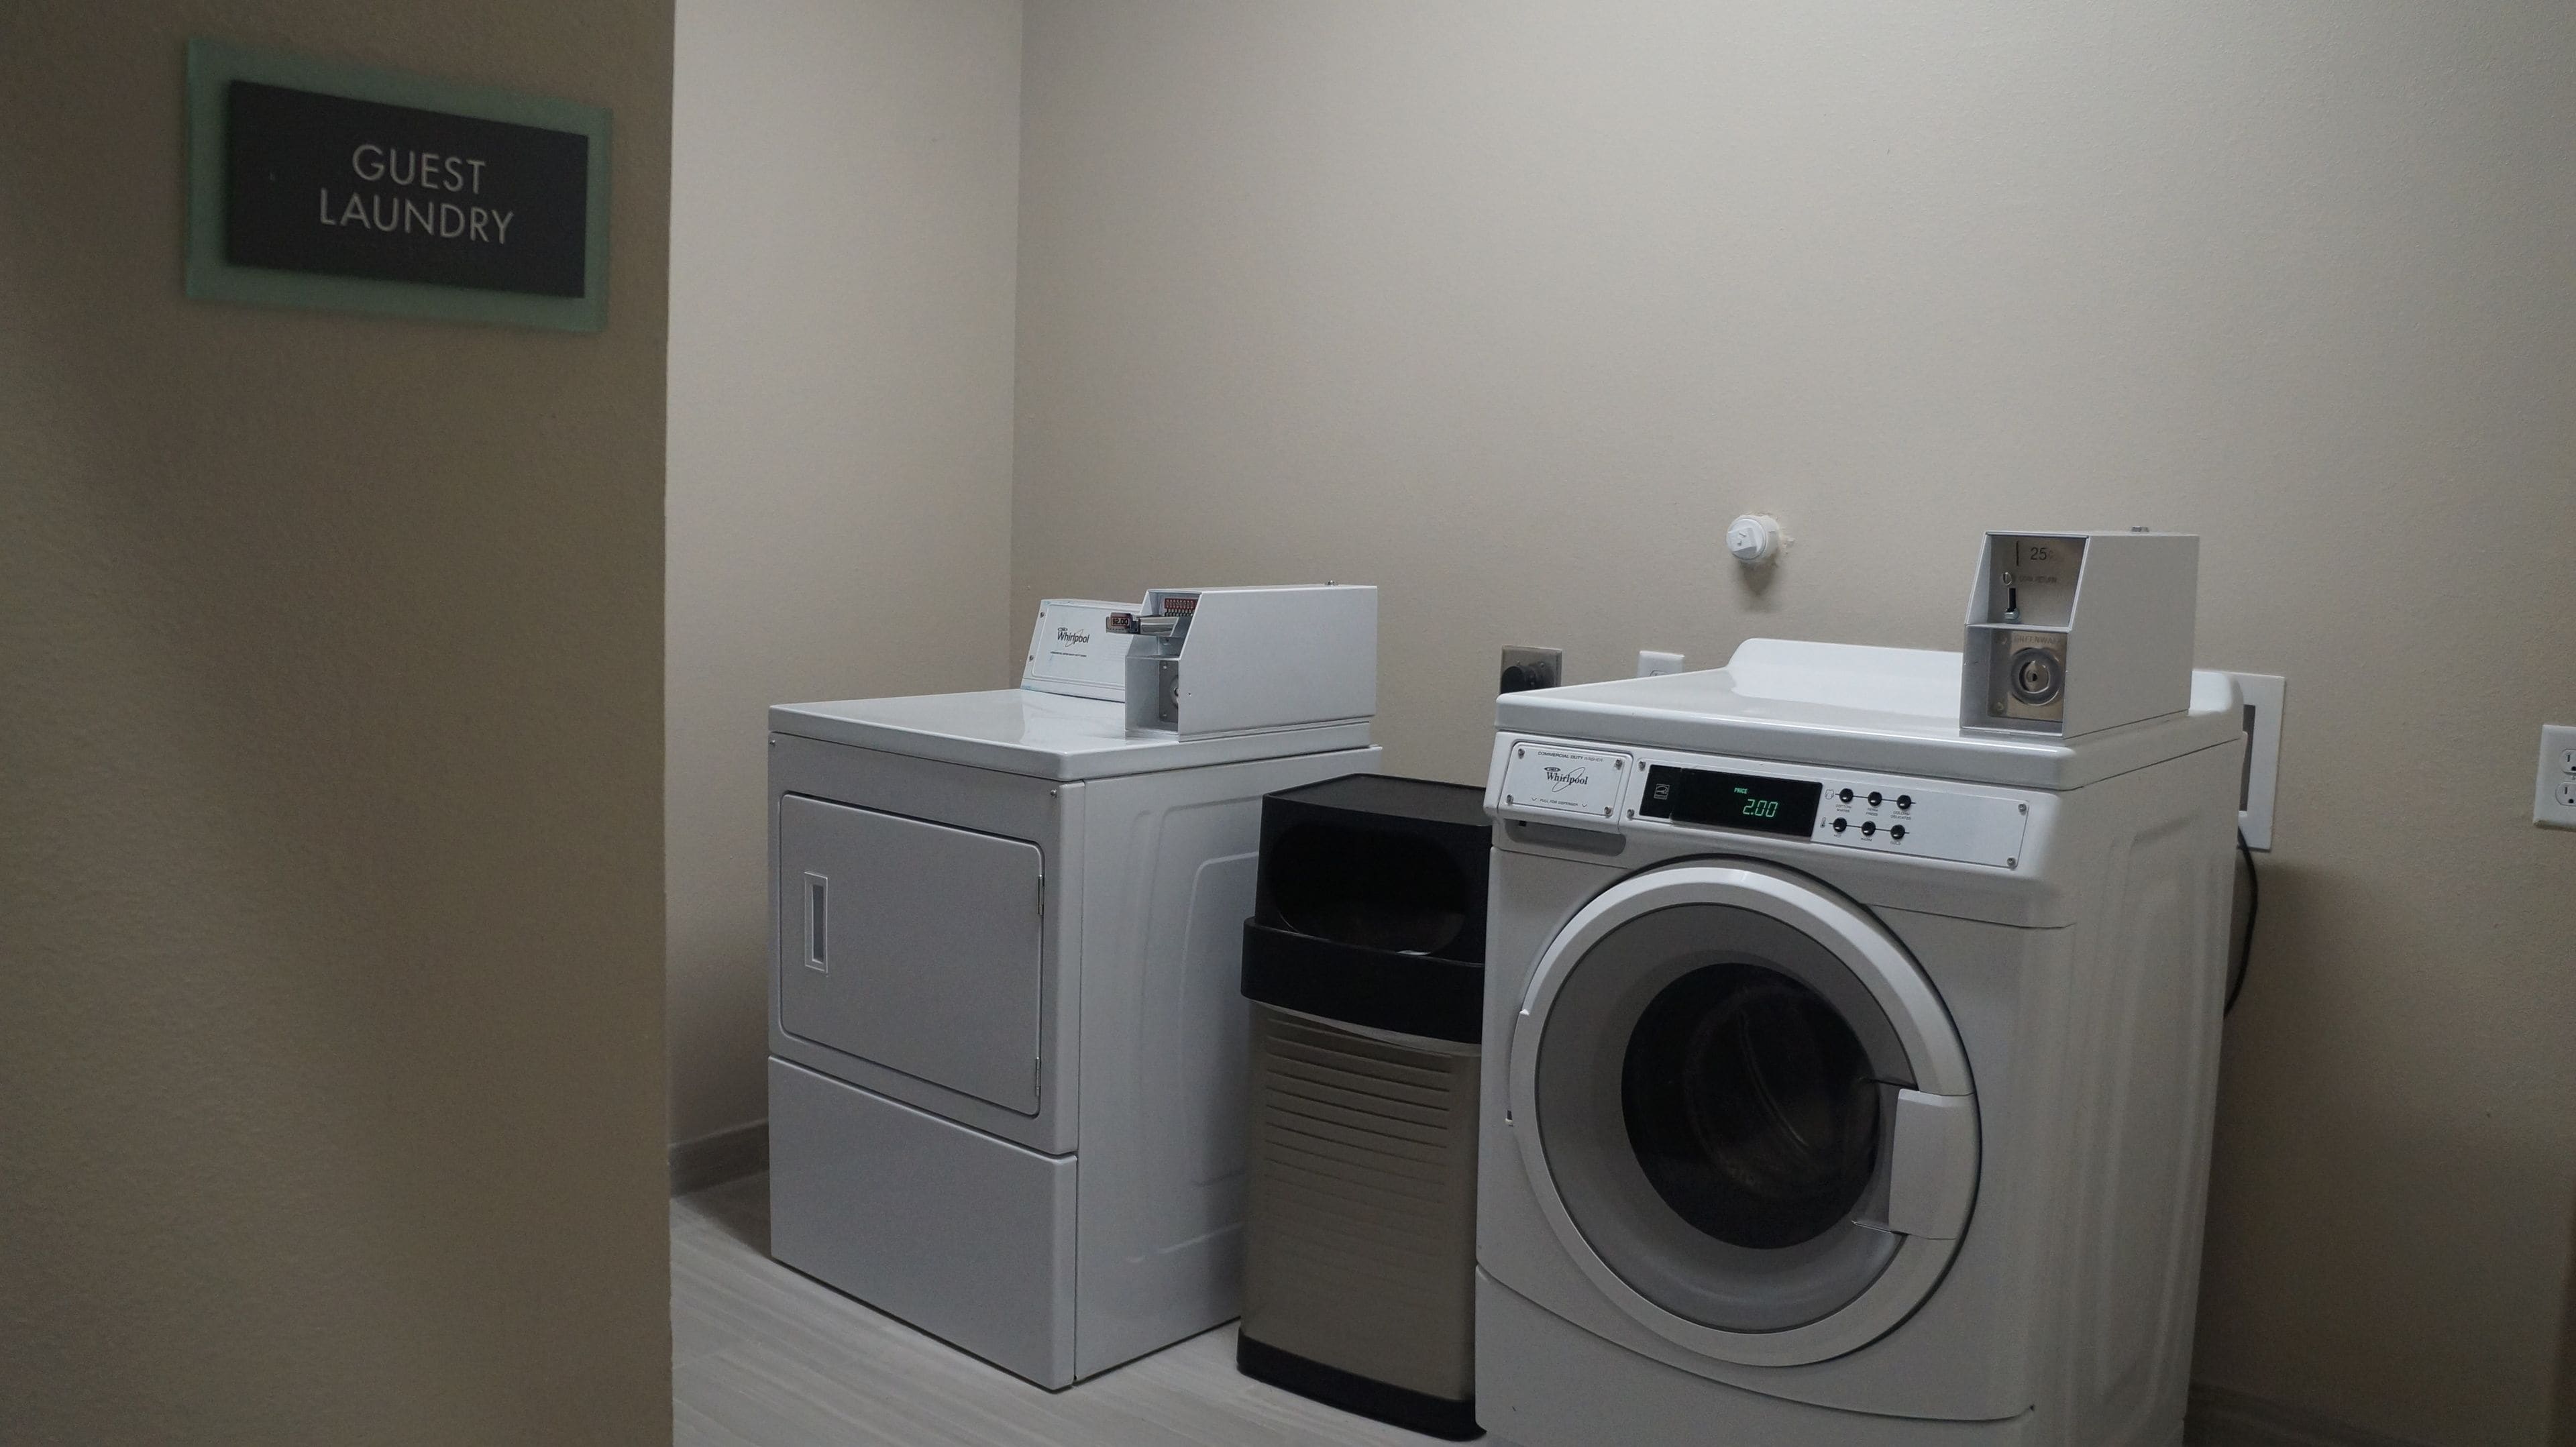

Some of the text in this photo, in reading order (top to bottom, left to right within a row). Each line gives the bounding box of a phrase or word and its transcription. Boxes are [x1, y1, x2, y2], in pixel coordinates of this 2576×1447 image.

[352, 144, 486, 195] GUEST
[319, 188, 515, 245] LAUNDRY
[1057, 631, 1090, 645] Whirlpool
[1538, 751, 1570, 759] COMMERCIAL
[1546, 771, 1589, 786] Whirlpool
[1742, 798, 1778, 818] 2.00
